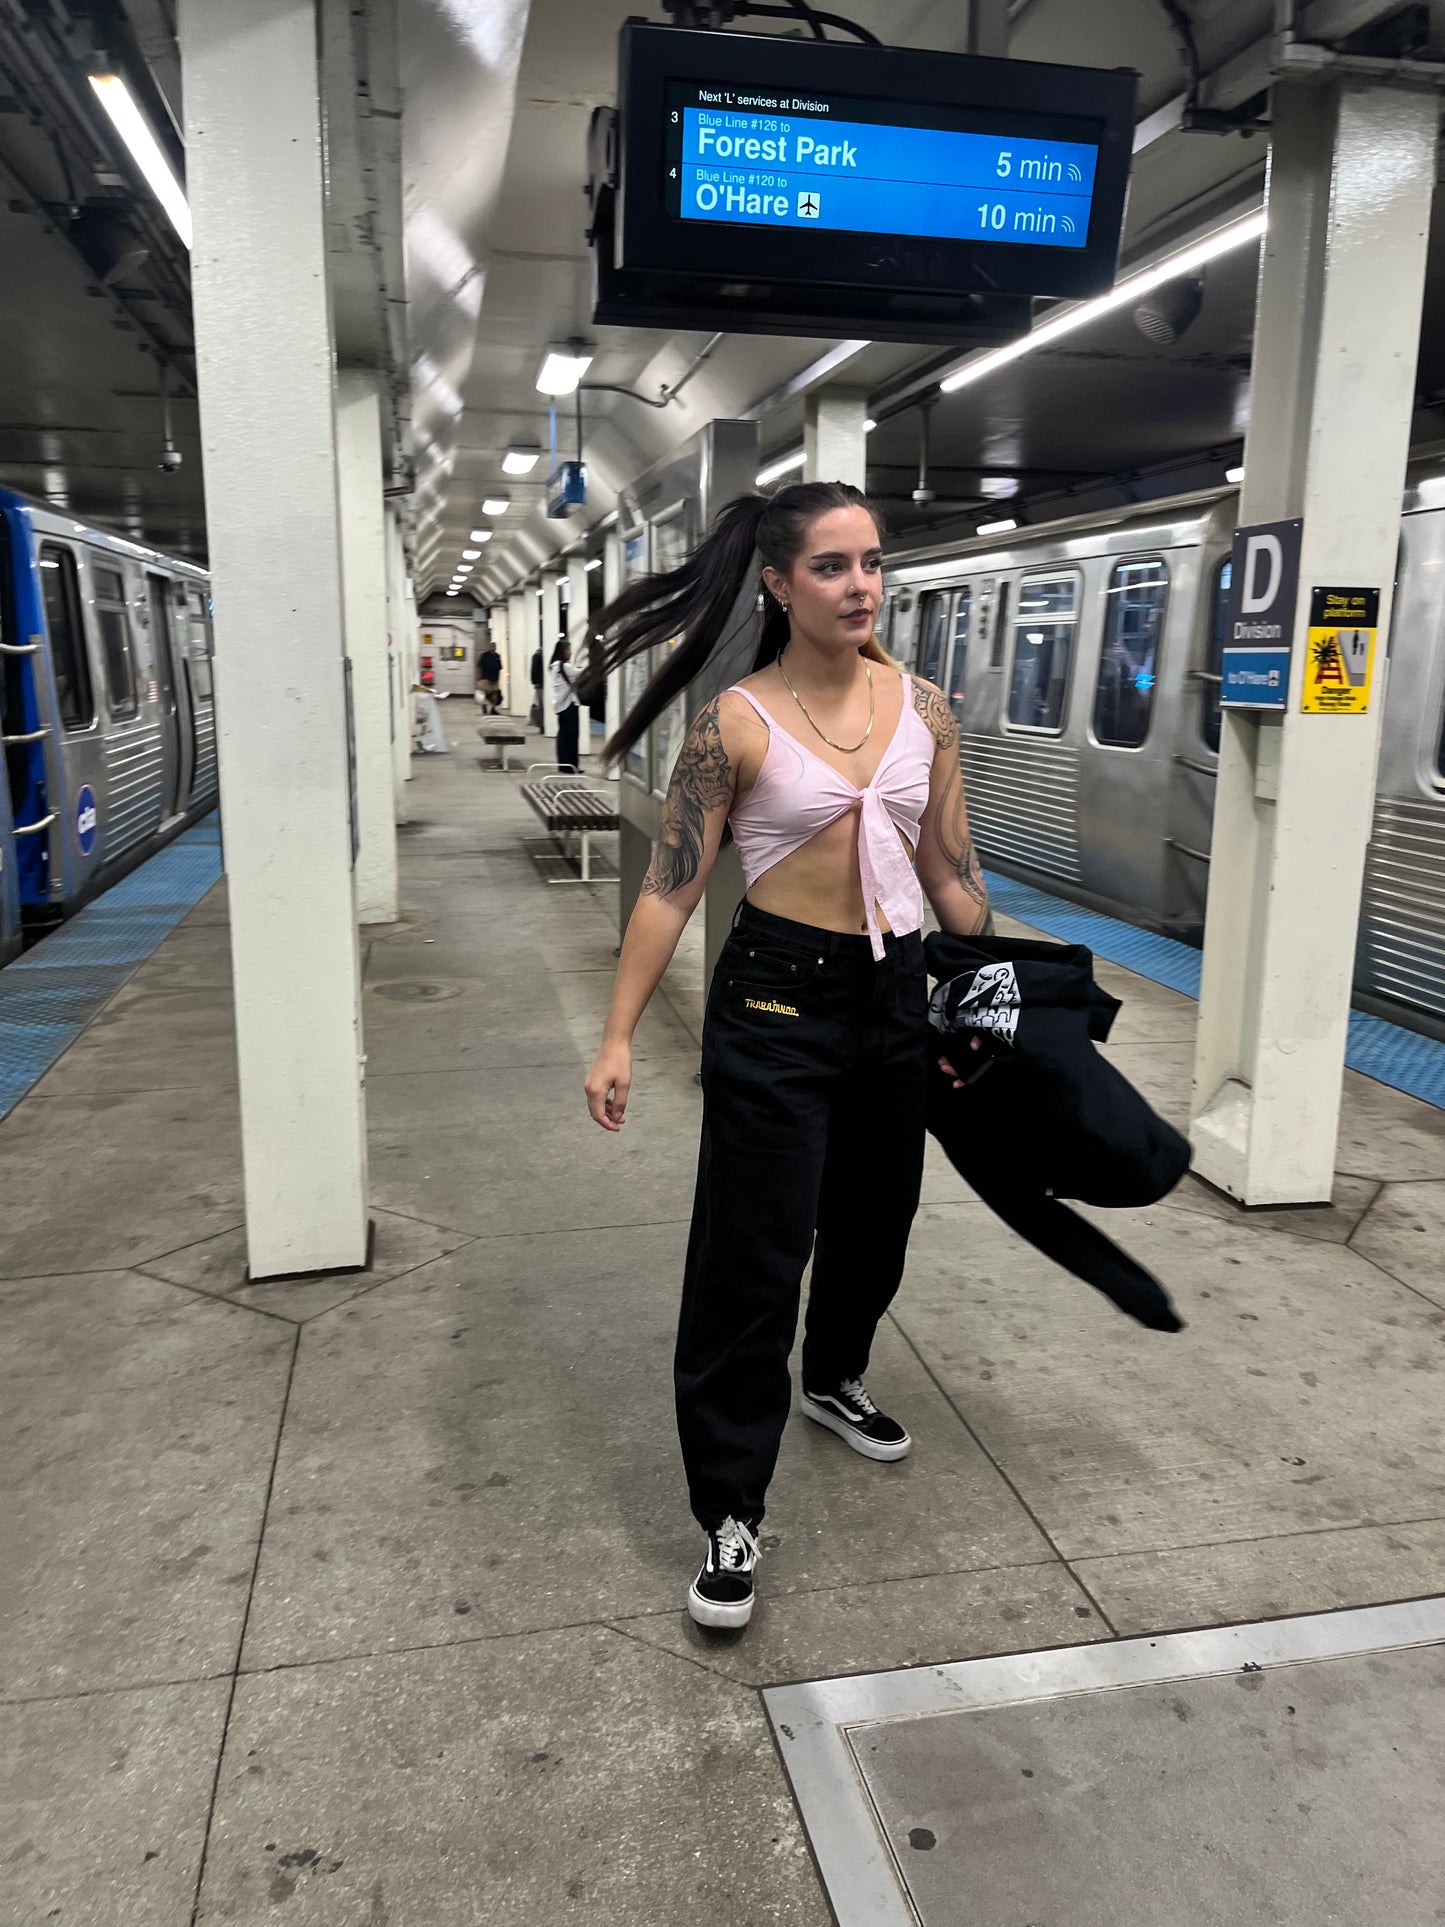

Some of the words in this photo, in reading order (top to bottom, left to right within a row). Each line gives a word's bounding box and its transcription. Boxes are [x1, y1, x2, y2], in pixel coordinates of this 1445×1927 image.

[698, 90, 721, 103] Next
[724, 92, 736, 104] 'L'
[737, 95, 777, 109] services
[780, 98, 789, 109] at
[792, 99, 829, 112] Division
[671, 111, 679, 123] 3
[698, 113, 722, 127] Blue
[725, 115, 748, 129] Line
[751, 119, 777, 132] #126
[780, 122, 790, 133] to
[698, 127, 787, 162] Forest
[796, 136, 857, 167] Park
[669, 167, 677, 179] 4
[996, 151, 1012, 178] 5
[1019, 154, 1062, 182] min
[696, 169, 719, 182] Blue
[723, 171, 745, 185] Line
[748, 174, 774, 188] #120
[777, 177, 787, 188] to
[695, 183, 789, 216] O'Hare
[977, 203, 1006, 230] 10
[1013, 207, 1056, 233] min
[1241, 534, 1283, 614] D
[1326, 594, 1349, 608] Stay
[1233, 621, 1281, 639] Division
